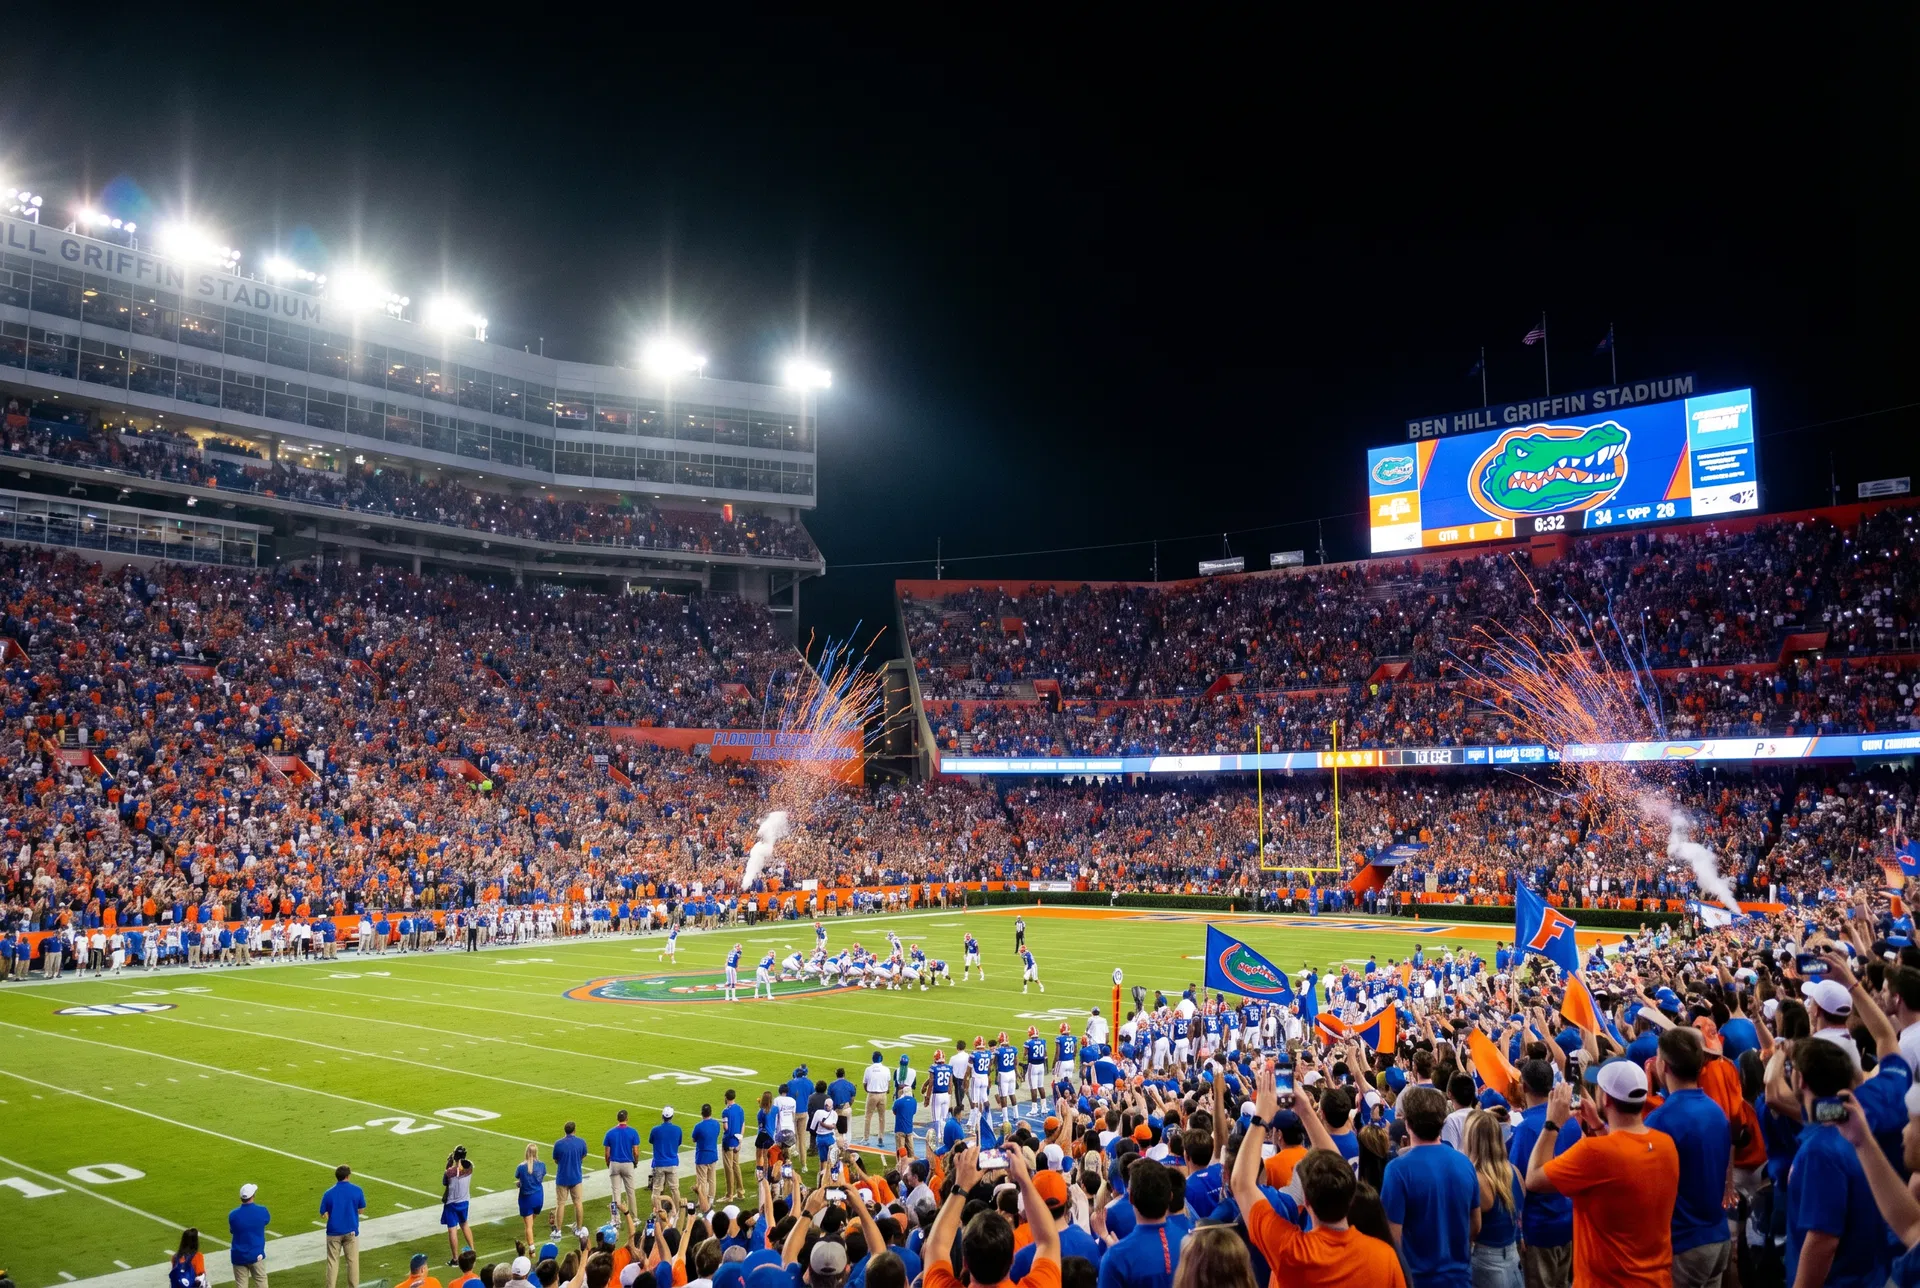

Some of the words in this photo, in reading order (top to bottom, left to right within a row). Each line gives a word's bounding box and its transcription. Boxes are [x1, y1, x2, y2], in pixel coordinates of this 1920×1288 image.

[60, 238, 184, 290] GRIFFIN
[198, 274, 321, 324] STADIUM
[1408, 419, 1447, 439] BEN
[1454, 411, 1497, 431] HILL
[1503, 395, 1585, 423] GRIFFIN
[1592, 376, 1693, 409] STADIUM
[1534, 515, 1565, 532] 6:32
[712, 732, 771, 746] FLORIDA
[1527, 907, 1576, 951] F
[869, 1034, 952, 1049] 40
[648, 1065, 758, 1085] 30
[364, 1107, 501, 1136] 20
[0, 1163, 147, 1199] 10
